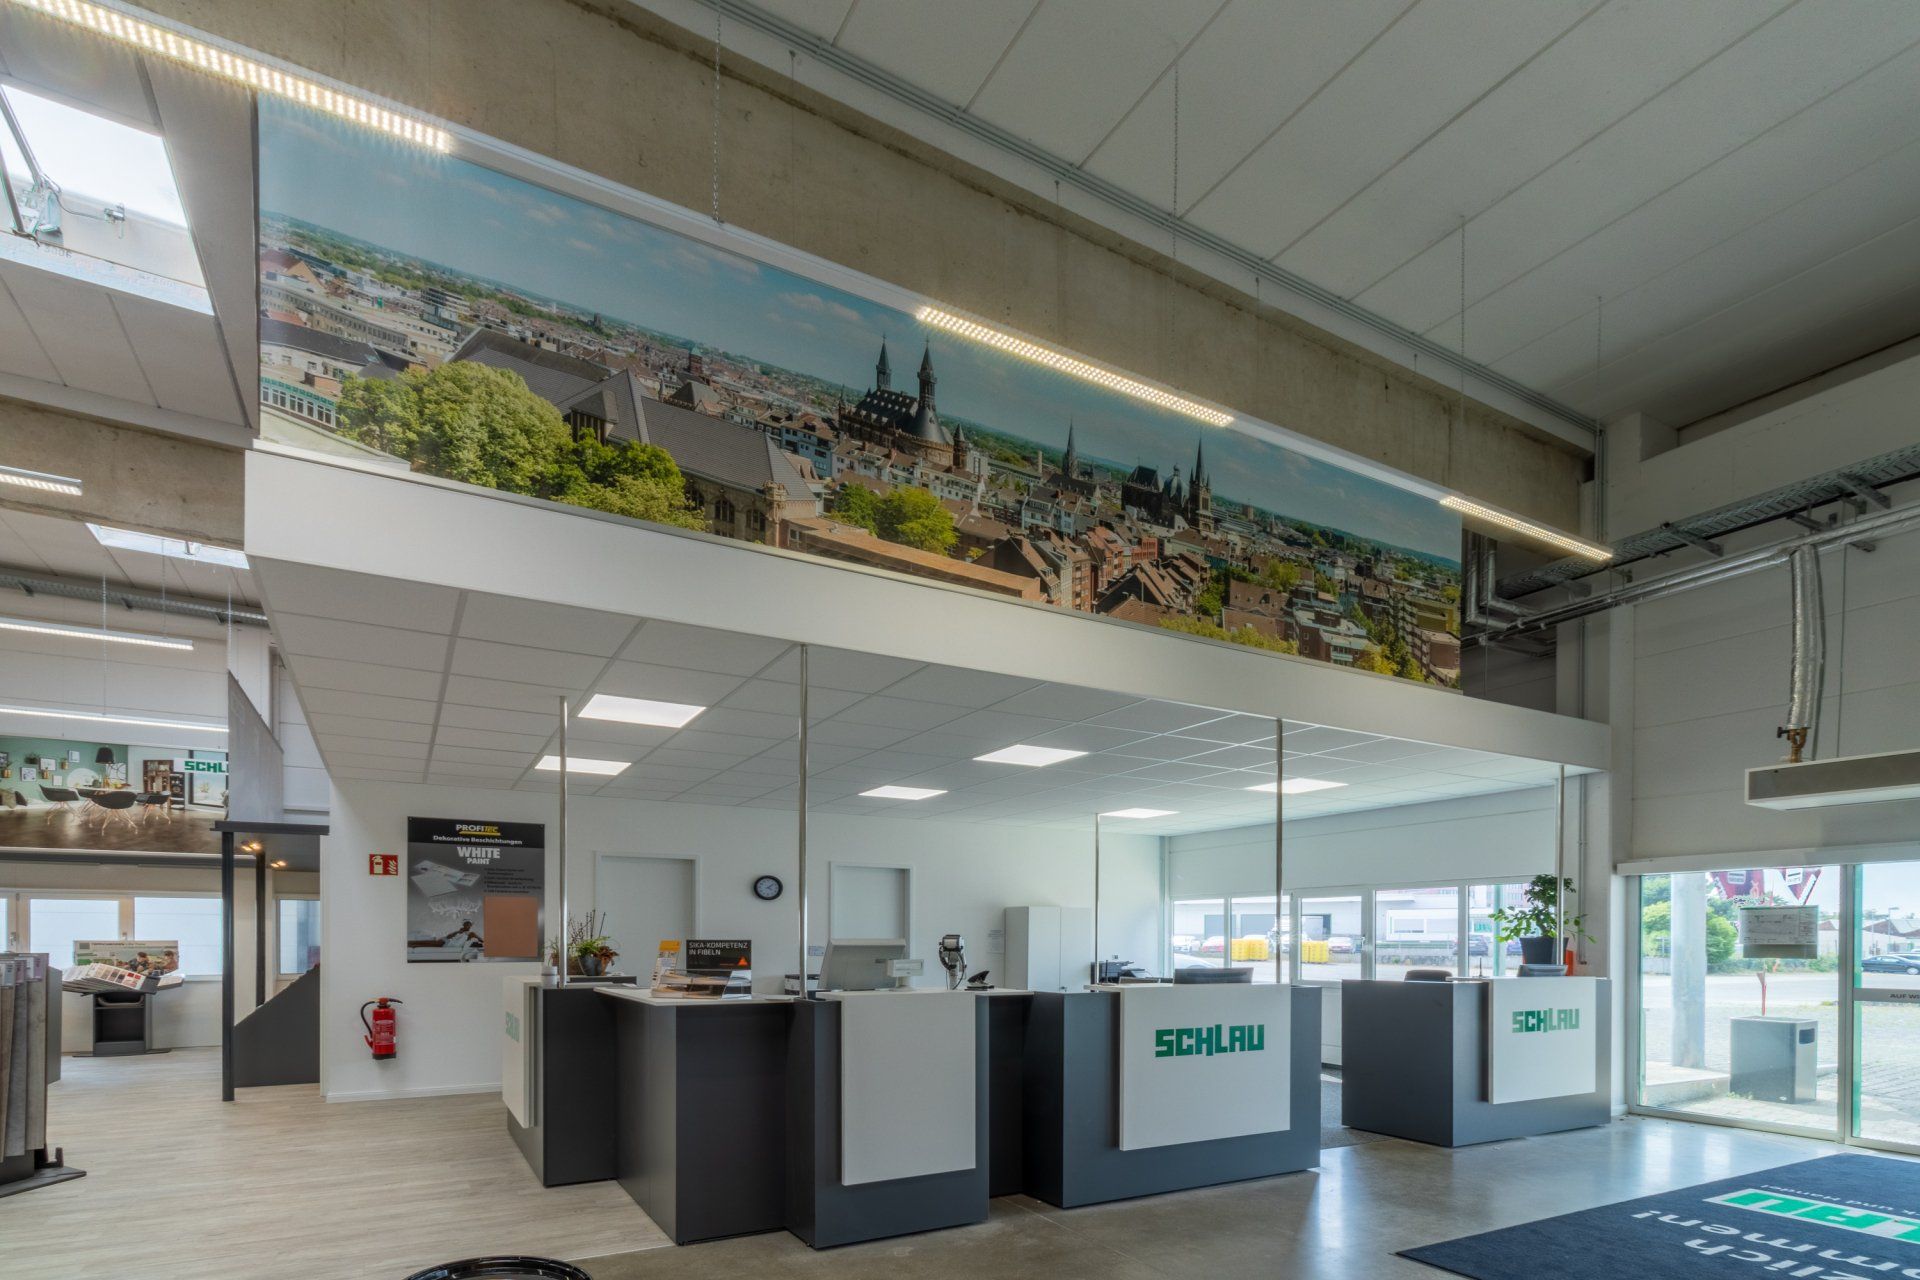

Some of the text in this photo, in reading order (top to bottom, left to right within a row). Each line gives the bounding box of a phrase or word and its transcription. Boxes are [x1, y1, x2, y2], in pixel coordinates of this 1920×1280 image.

[184, 760, 226, 773] SCHL
[456, 824, 499, 832] PROFITEC
[471, 837, 523, 845] Beschichtungen
[457, 846, 501, 859] WHITE
[466, 857, 490, 865] PAINT
[1512, 1007, 1580, 1033] SCHLAU
[1155, 1024, 1265, 1058] SCHLAU
[1760, 1184, 1841, 1201] Handel
